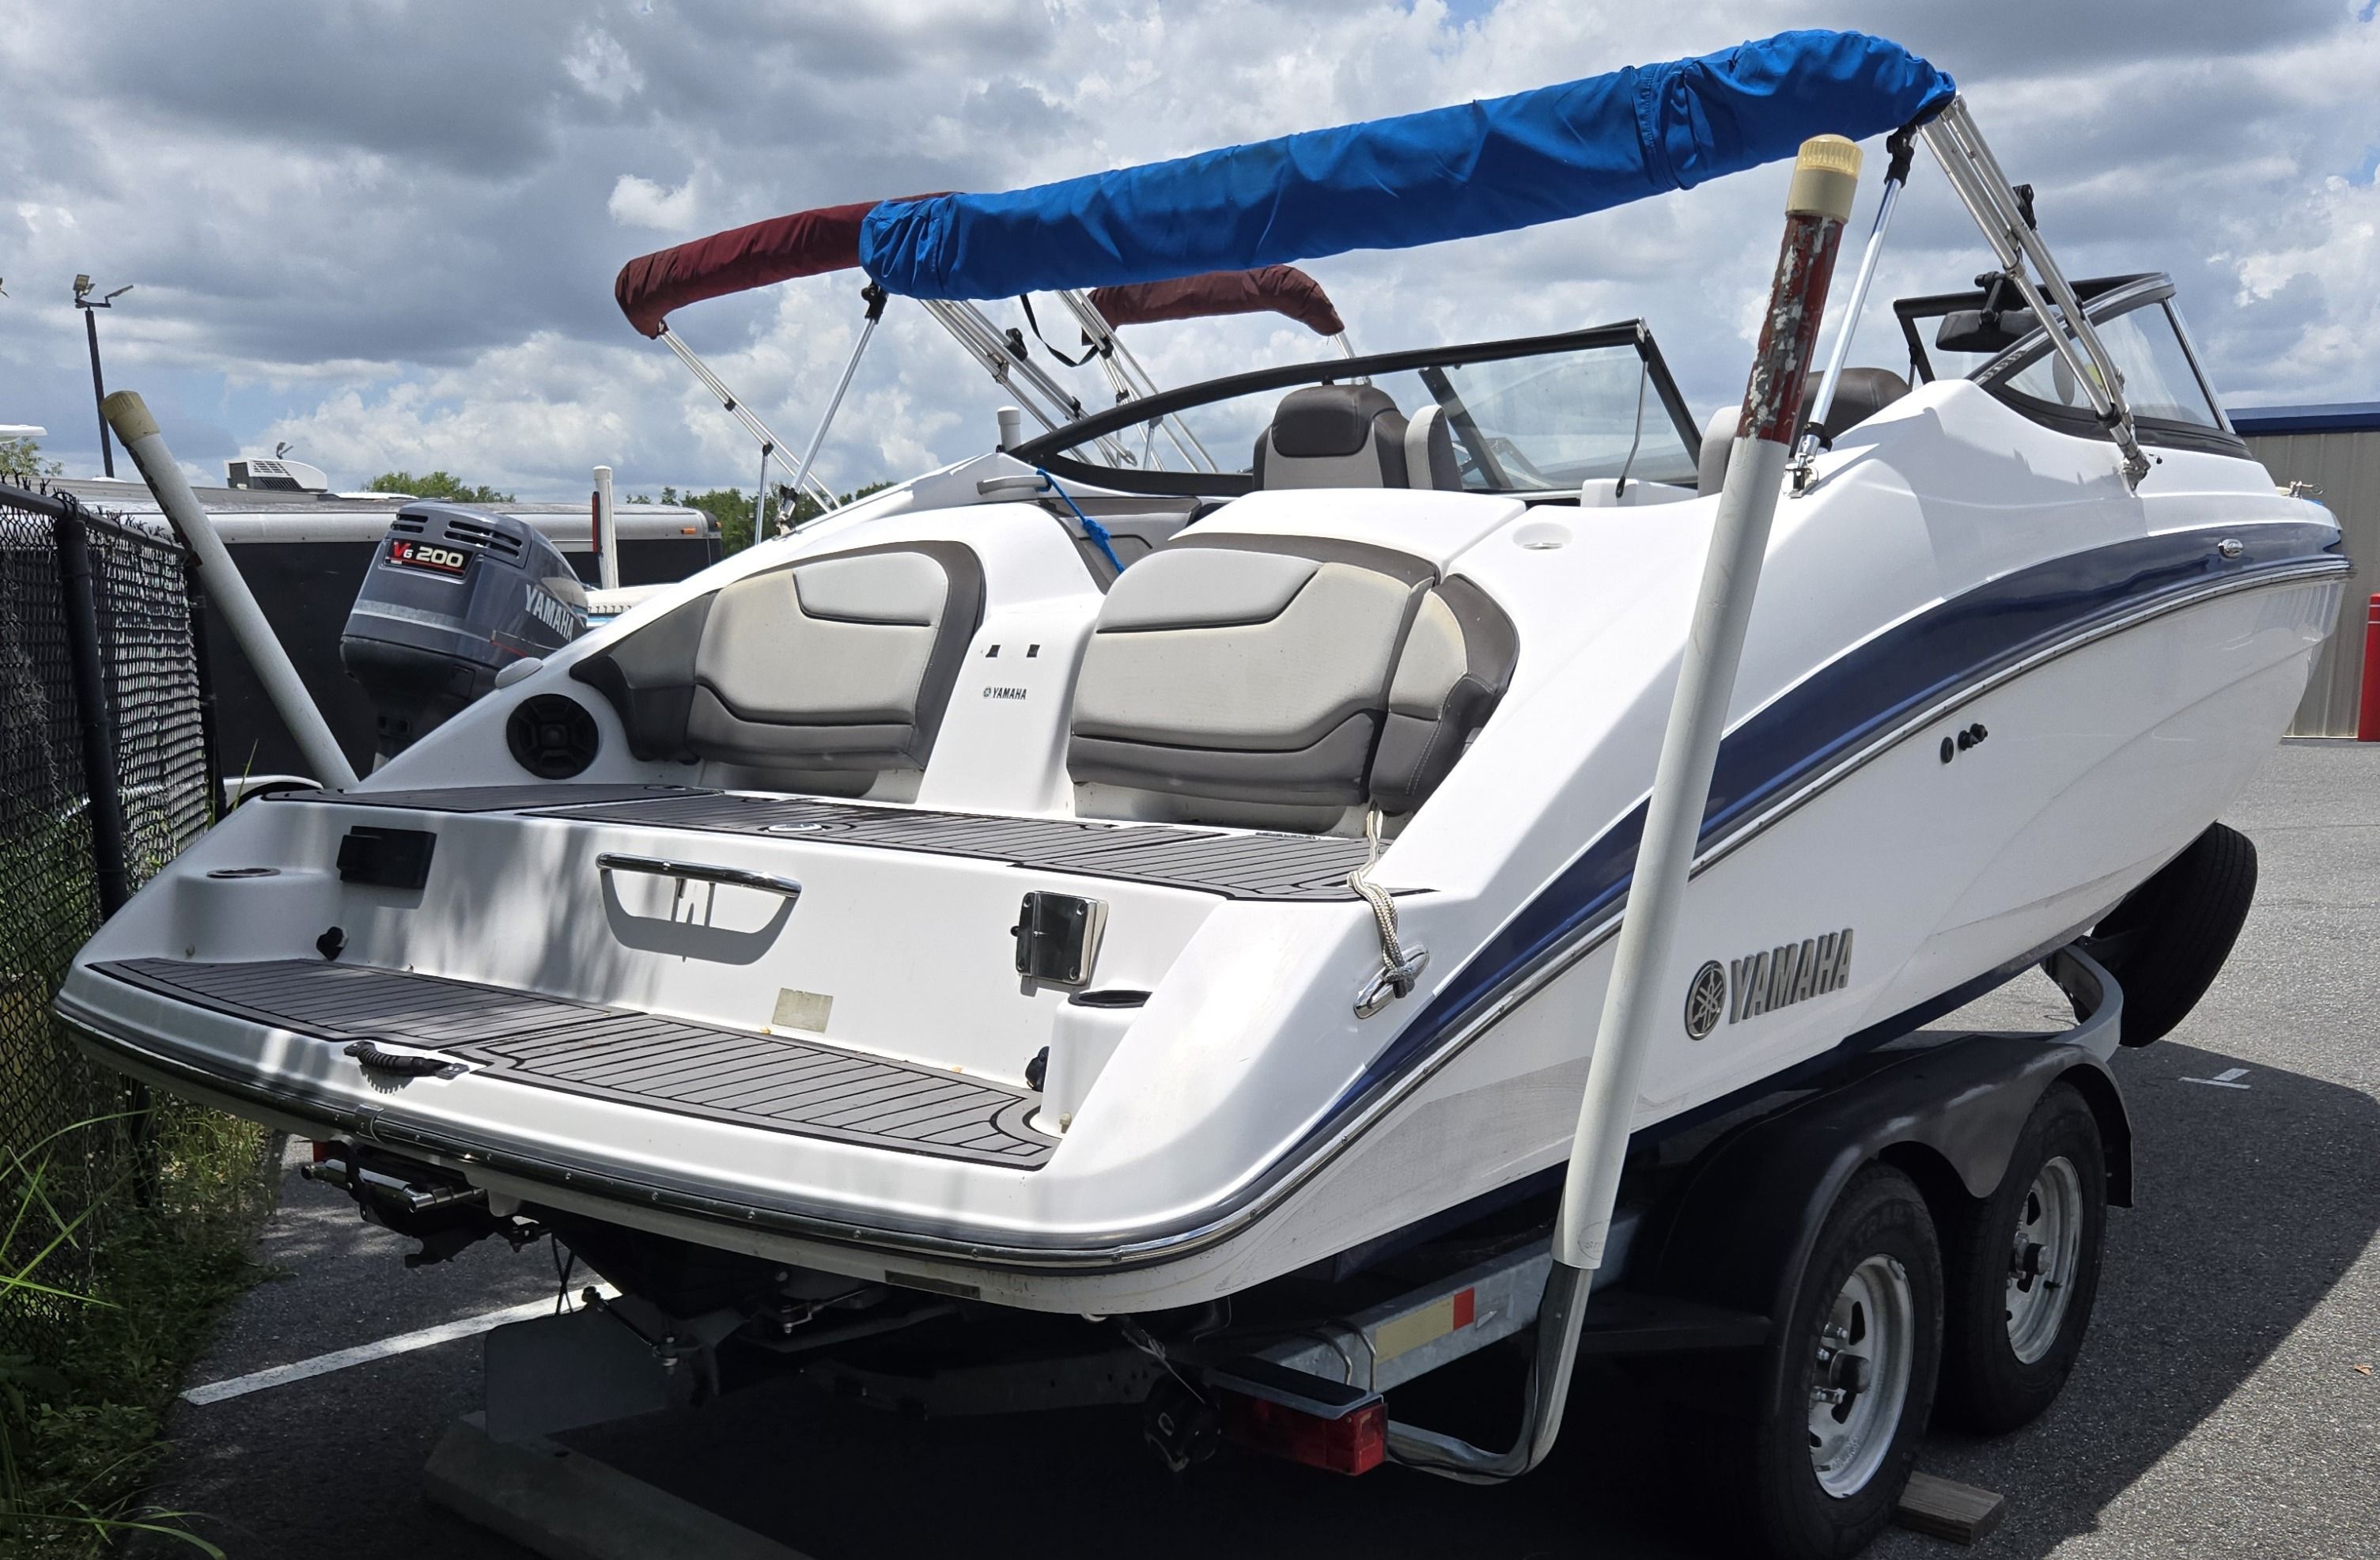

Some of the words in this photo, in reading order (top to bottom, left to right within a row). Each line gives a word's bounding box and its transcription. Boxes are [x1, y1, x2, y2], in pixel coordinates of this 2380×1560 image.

[393, 540, 413, 558] V6
[415, 546, 464, 568] 200
[525, 584, 574, 642] YAMAHA
[993, 687, 1027, 700] YAMAHA
[1729, 928, 1853, 1024] YAMAHA
